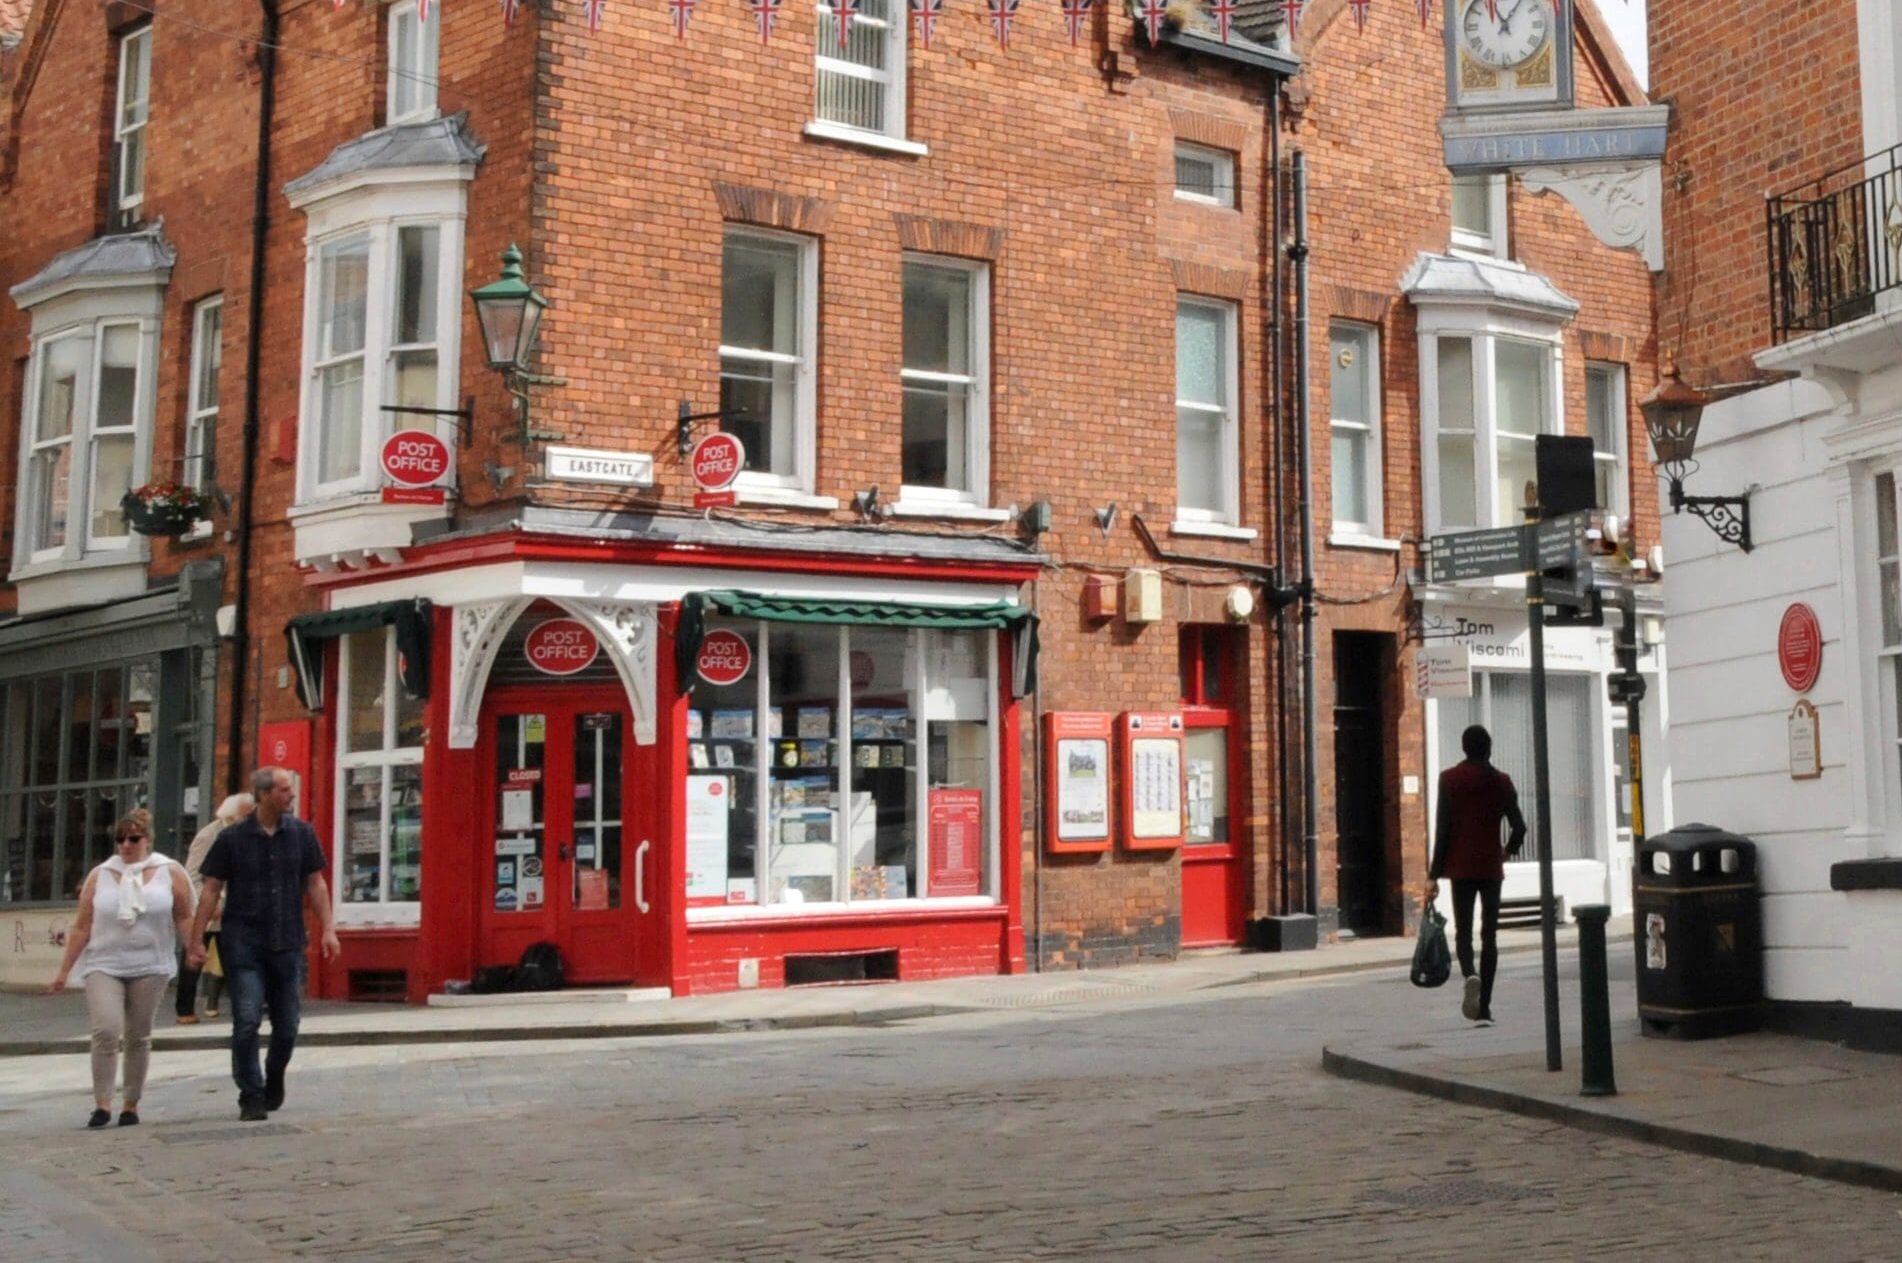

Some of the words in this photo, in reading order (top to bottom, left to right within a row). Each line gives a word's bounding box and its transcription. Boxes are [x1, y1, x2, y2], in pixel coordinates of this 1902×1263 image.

[1565, 133, 1637, 155] HART
[398, 441, 437, 457] POST
[703, 444, 731, 459] POST
[387, 456, 441, 473] OFFICE
[697, 458, 734, 475] OFFICE
[1456, 617, 1494, 635] Tom
[543, 631, 583, 645] POST
[534, 645, 588, 659] OFFICE
[707, 641, 738, 655] POST
[700, 656, 743, 670] OFFICE
